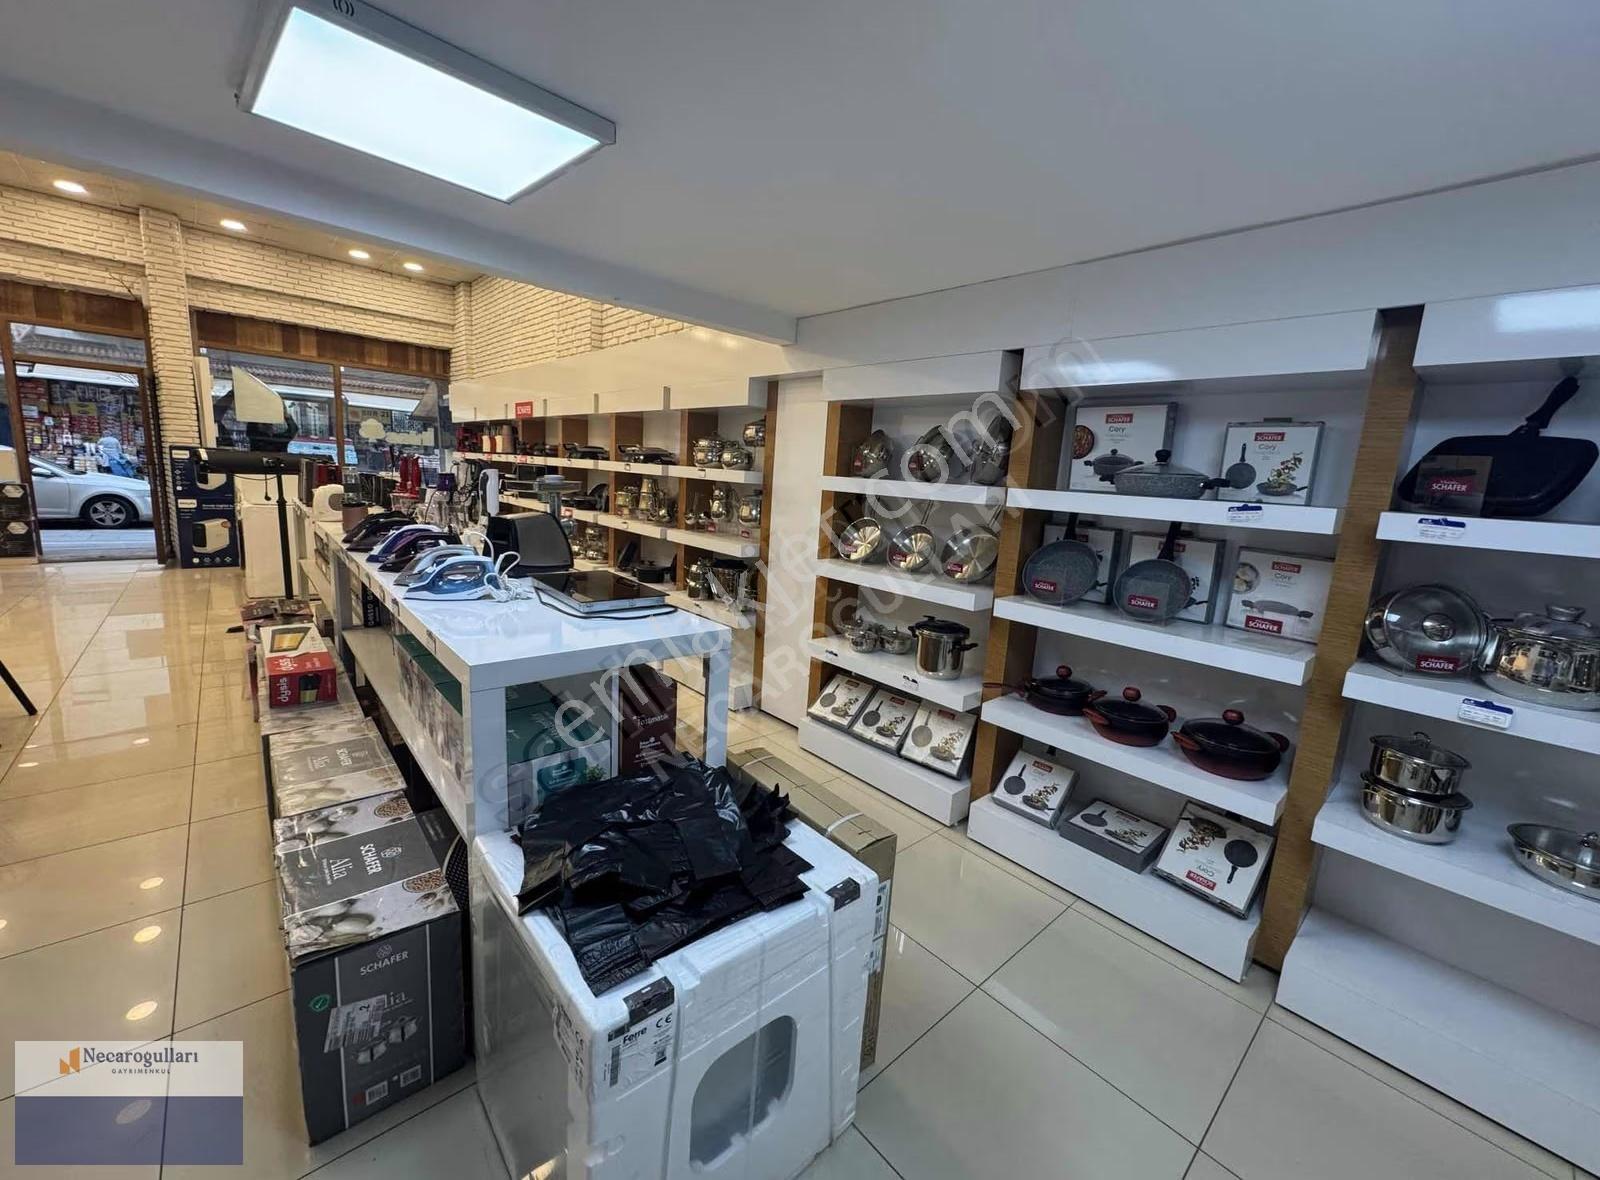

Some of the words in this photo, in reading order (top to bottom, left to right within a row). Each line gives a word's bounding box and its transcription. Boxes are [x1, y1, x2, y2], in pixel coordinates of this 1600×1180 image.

[1431, 483, 1468, 492] SCHAFER
[1130, 599, 1155, 608] SCHAFER
[1248, 620, 1280, 632] SCHAFER
[1420, 661, 1454, 670] SCHAFER
[277, 677, 291, 702] dysis
[360, 843, 382, 875] SCHAFER
[329, 858, 352, 880] Alia
[360, 951, 408, 976] SCHAFER
[623, 1027, 648, 1045] Ferre
